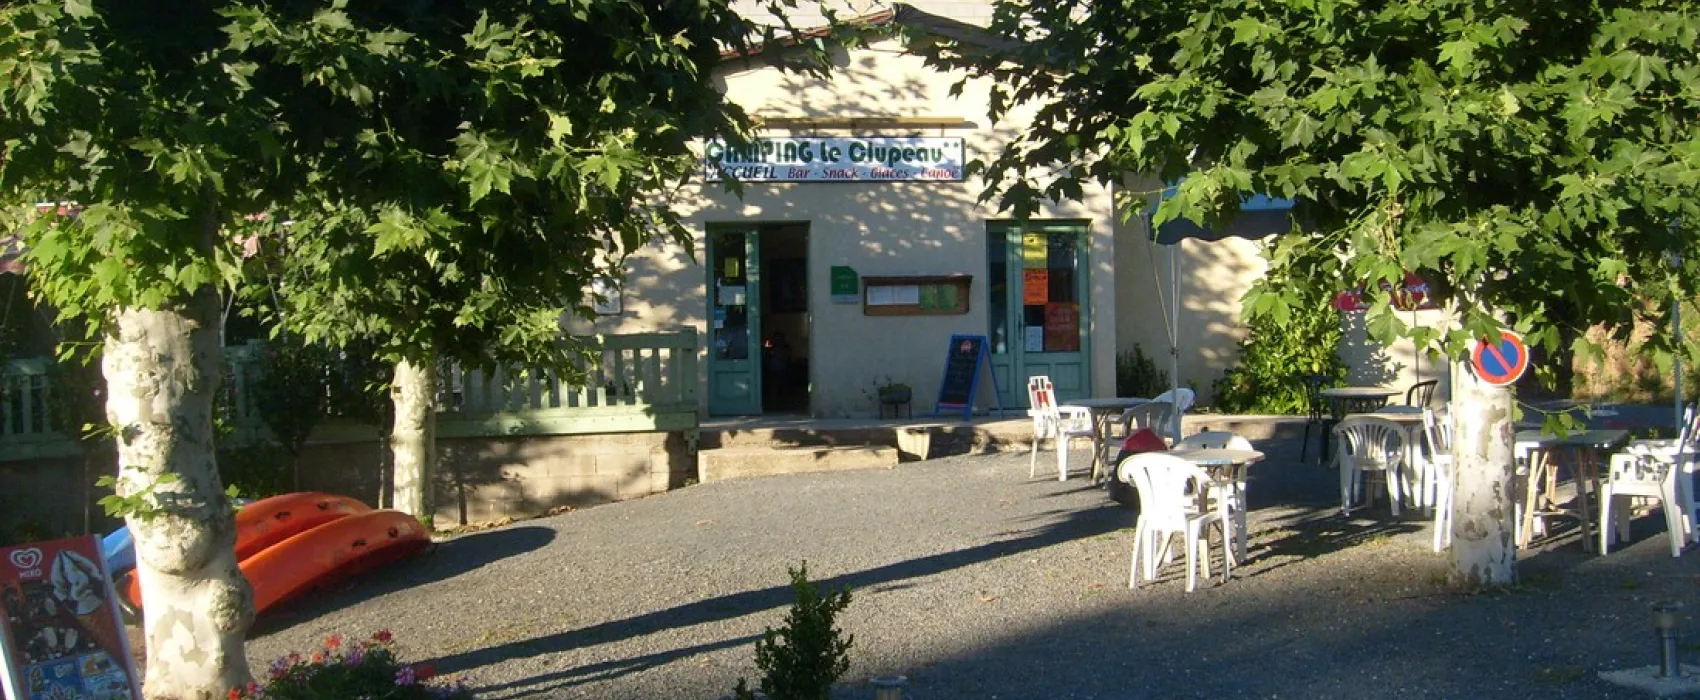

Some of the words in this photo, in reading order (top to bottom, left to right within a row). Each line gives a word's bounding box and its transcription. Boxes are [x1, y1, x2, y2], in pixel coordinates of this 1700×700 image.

[849, 141, 942, 168] Clupeau
[787, 167, 811, 179] Bar
[821, 167, 859, 179] Snack
[870, 167, 909, 179] Glaces
